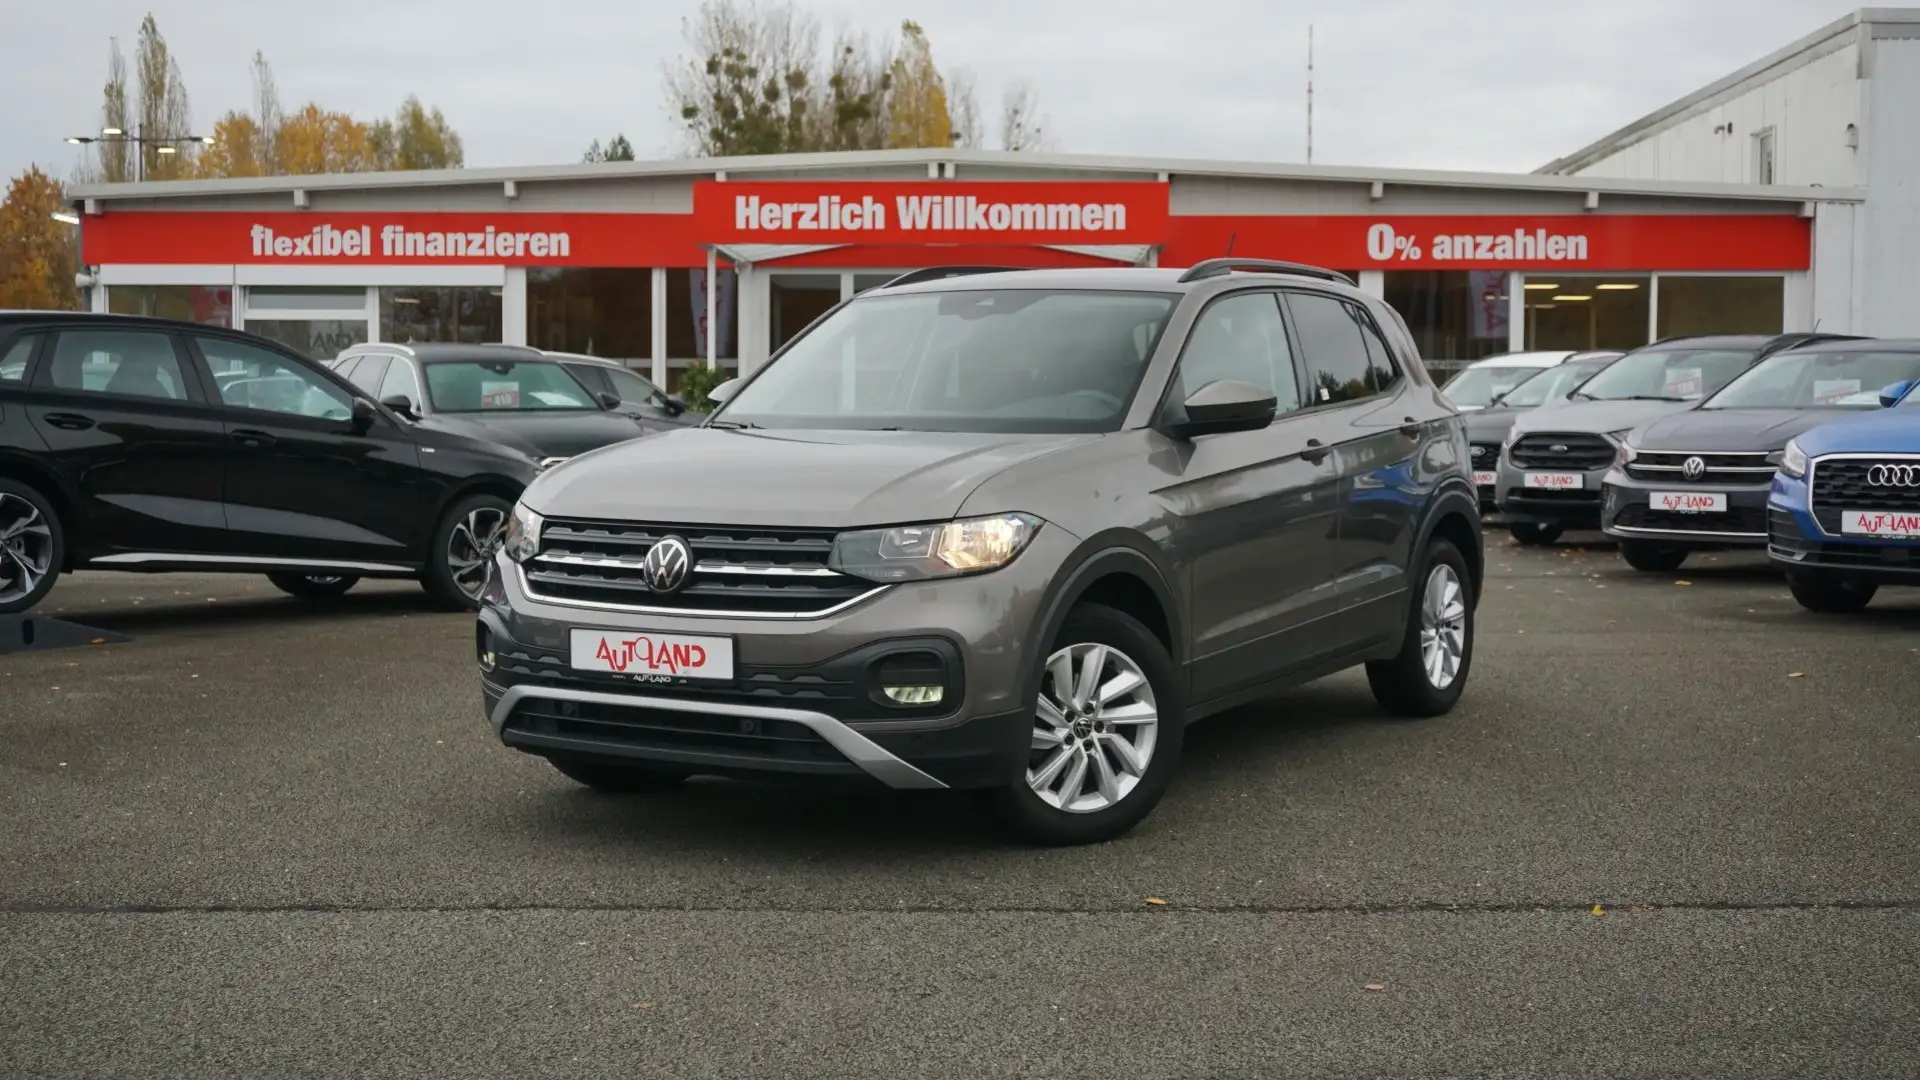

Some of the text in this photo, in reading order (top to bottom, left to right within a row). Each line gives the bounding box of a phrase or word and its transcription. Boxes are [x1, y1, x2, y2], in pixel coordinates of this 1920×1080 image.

[735, 195, 1127, 231] Herzlich Willkommen
[251, 223, 570, 257] flexibel finanzieren
[1366, 223, 1588, 261] 0% anzahlen
[1857, 513, 1920, 533] AUTOLAN
[596, 636, 707, 675] AUTOLAND
